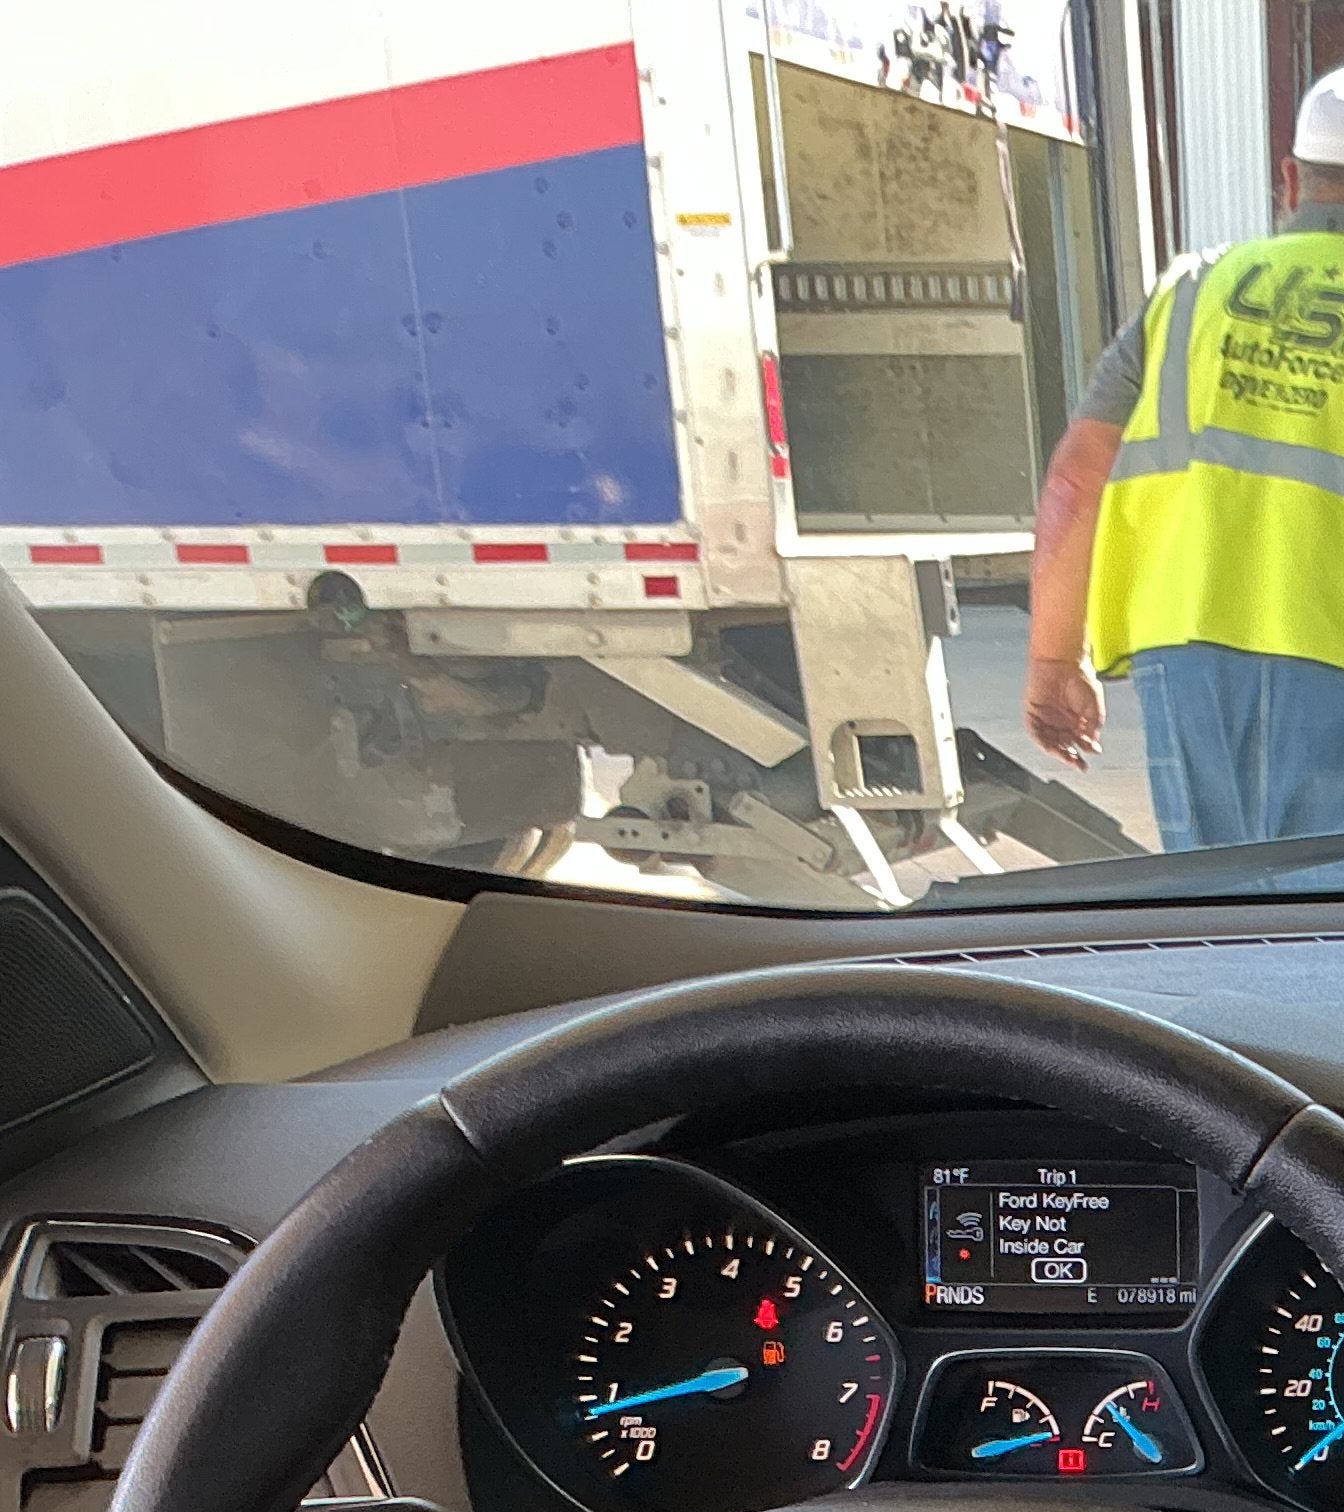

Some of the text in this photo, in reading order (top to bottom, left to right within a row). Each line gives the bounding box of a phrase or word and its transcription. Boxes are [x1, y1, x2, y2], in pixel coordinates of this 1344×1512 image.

[1037, 1168, 1077, 1187] Trip 1
[998, 1192, 1111, 1213] Ford KeyFree
[999, 1215, 1068, 1236] Key Not
[999, 1238, 1085, 1255] Inside Car
[720, 1258, 741, 1280] 4
[1043, 1261, 1074, 1280] OK
[658, 1276, 678, 1299] 3
[783, 1275, 803, 1299] 5
[924, 1283, 985, 1306] PRNDS
[1087, 1288, 1098, 1304] E
[1117, 1288, 1177, 1305] 078918
[613, 1322, 634, 1344] 2
[825, 1321, 844, 1344] 6
[1294, 1313, 1323, 1333] 40
[608, 1382, 620, 1403] 1
[839, 1382, 859, 1404] 7
[1283, 1379, 1312, 1398] 20
[980, 1396, 999, 1413] F
[1141, 1397, 1161, 1412] H
[811, 1438, 832, 1461] 8
[1097, 1431, 1116, 1448] C
[635, 1440, 657, 1462] 0
